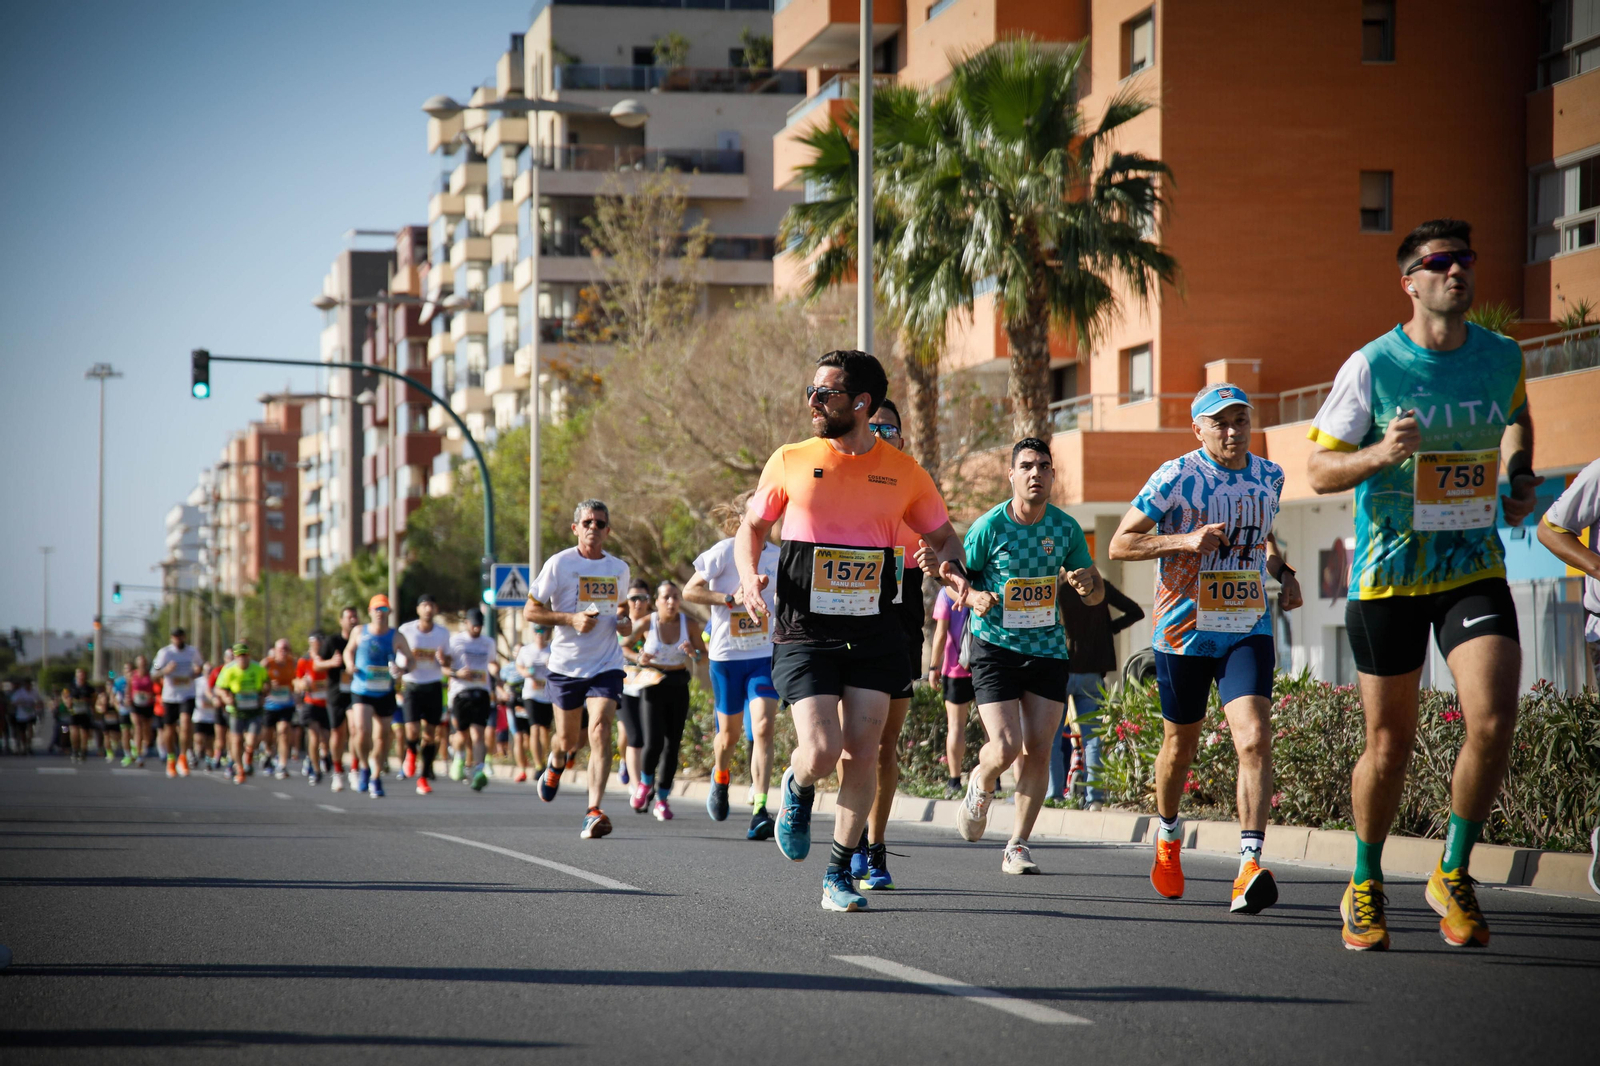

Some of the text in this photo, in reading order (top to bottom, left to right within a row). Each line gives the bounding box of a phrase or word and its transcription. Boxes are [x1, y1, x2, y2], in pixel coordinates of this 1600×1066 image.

[867, 474, 898, 483] COSENTINO
[1435, 464, 1485, 489] 758
[822, 560, 877, 581] 1572
[584, 582, 615, 595] 1232
[1010, 585, 1052, 601] 2083
[1207, 581, 1260, 600] 1058
